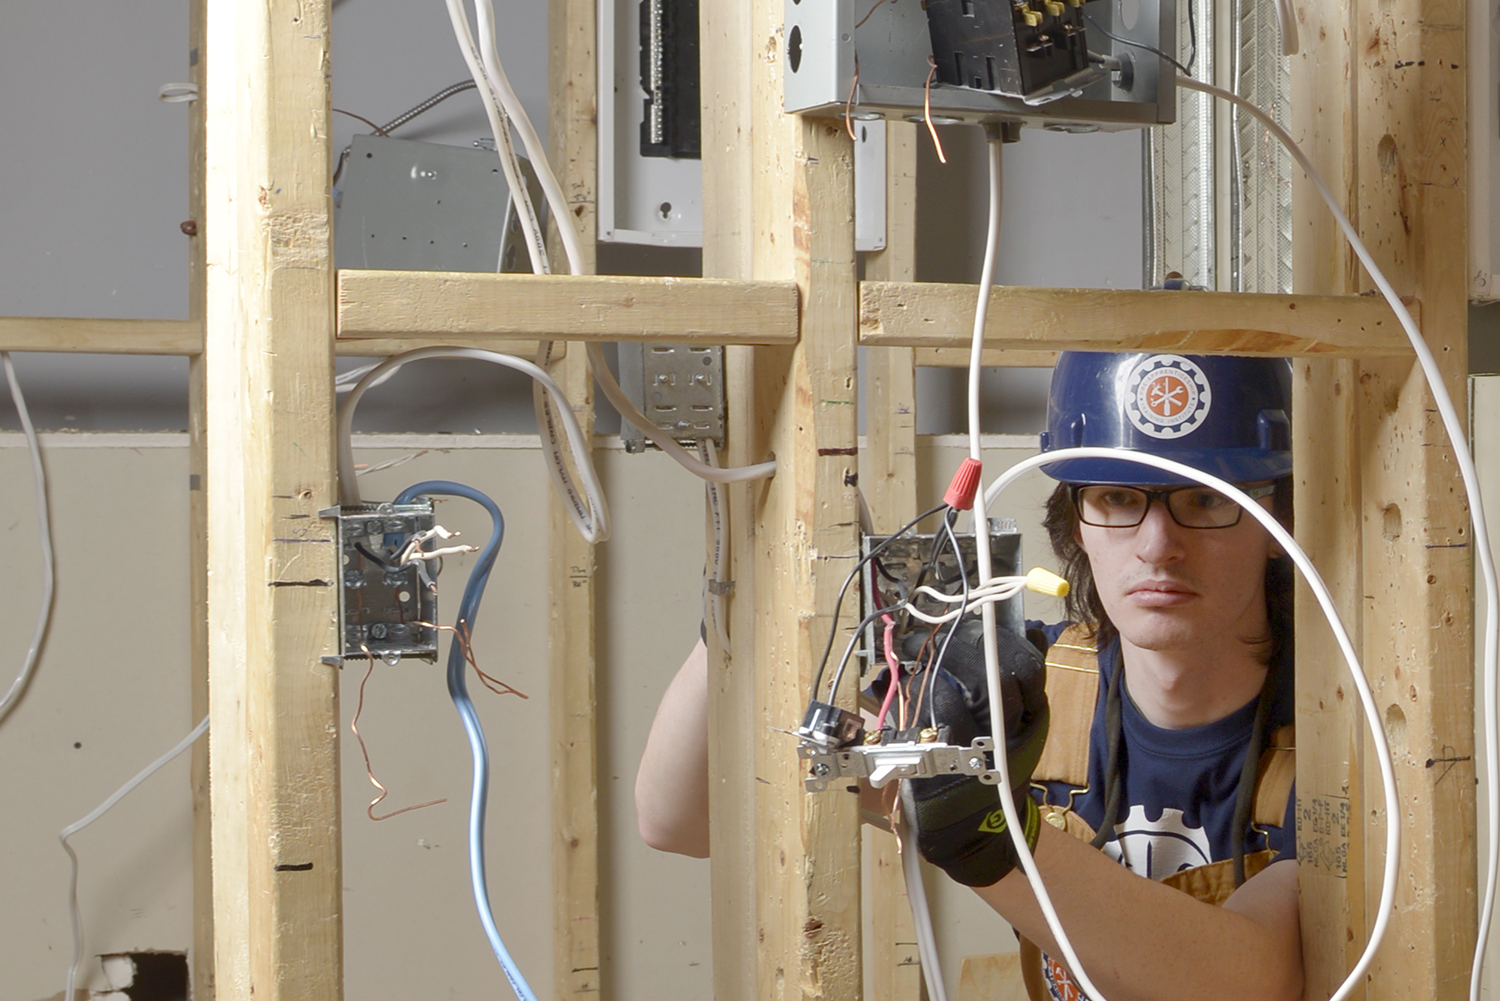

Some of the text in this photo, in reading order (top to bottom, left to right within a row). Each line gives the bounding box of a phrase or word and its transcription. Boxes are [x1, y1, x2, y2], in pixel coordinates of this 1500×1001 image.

[543, 401, 557, 445] CABLES
[552, 451, 568, 484] NYLON
[1303, 808, 1311, 821] 2
[1331, 812, 1340, 825] 2
